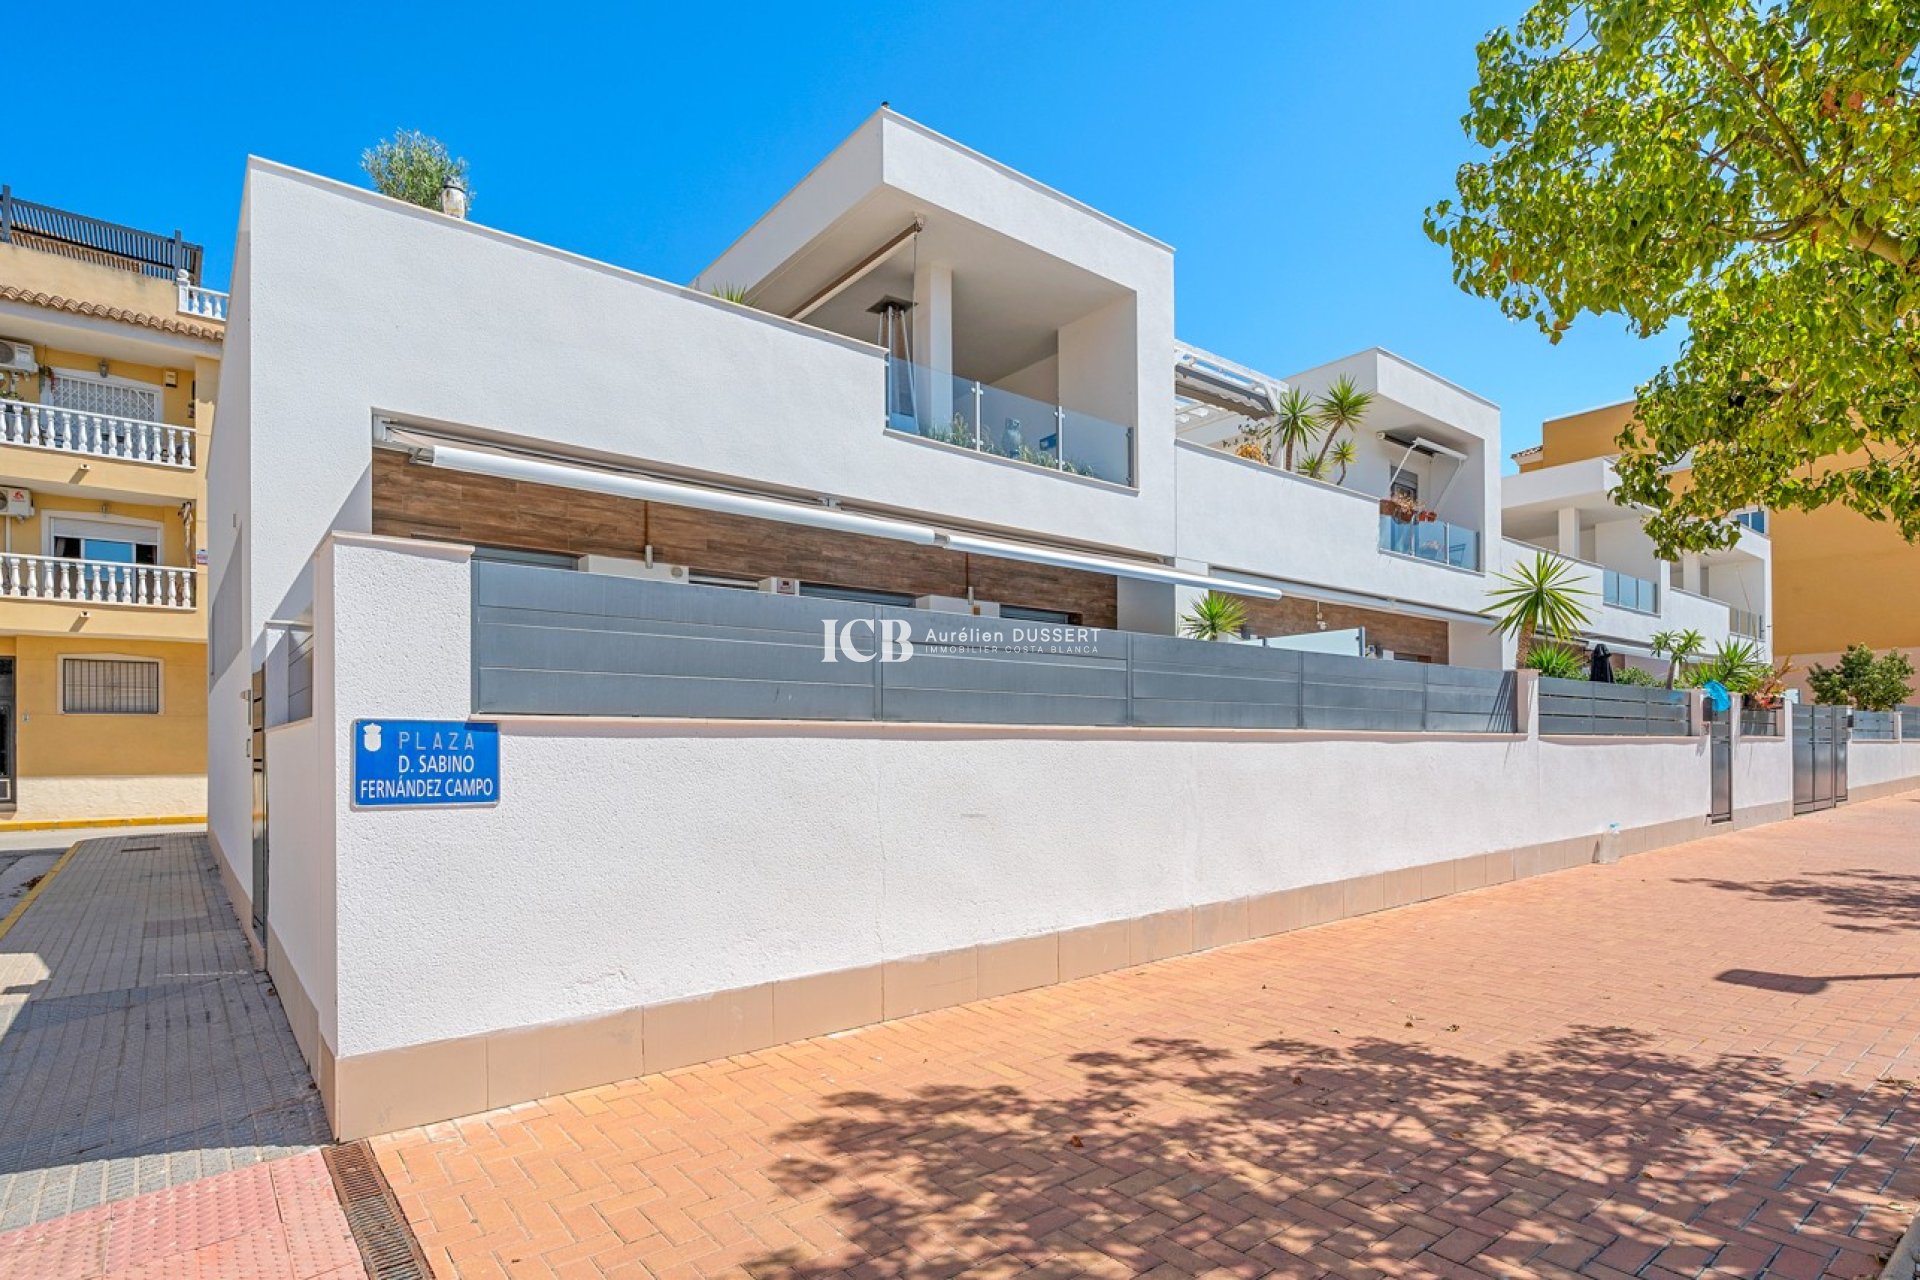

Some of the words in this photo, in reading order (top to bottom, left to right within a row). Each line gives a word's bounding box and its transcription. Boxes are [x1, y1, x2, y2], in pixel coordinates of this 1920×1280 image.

[399, 731, 474, 750] PLAZA
[398, 755, 414, 773] D.
[419, 755, 474, 773] SABINO
[360, 775, 441, 799] FERNÁNDEZ
[445, 778, 494, 797] CAMPO
